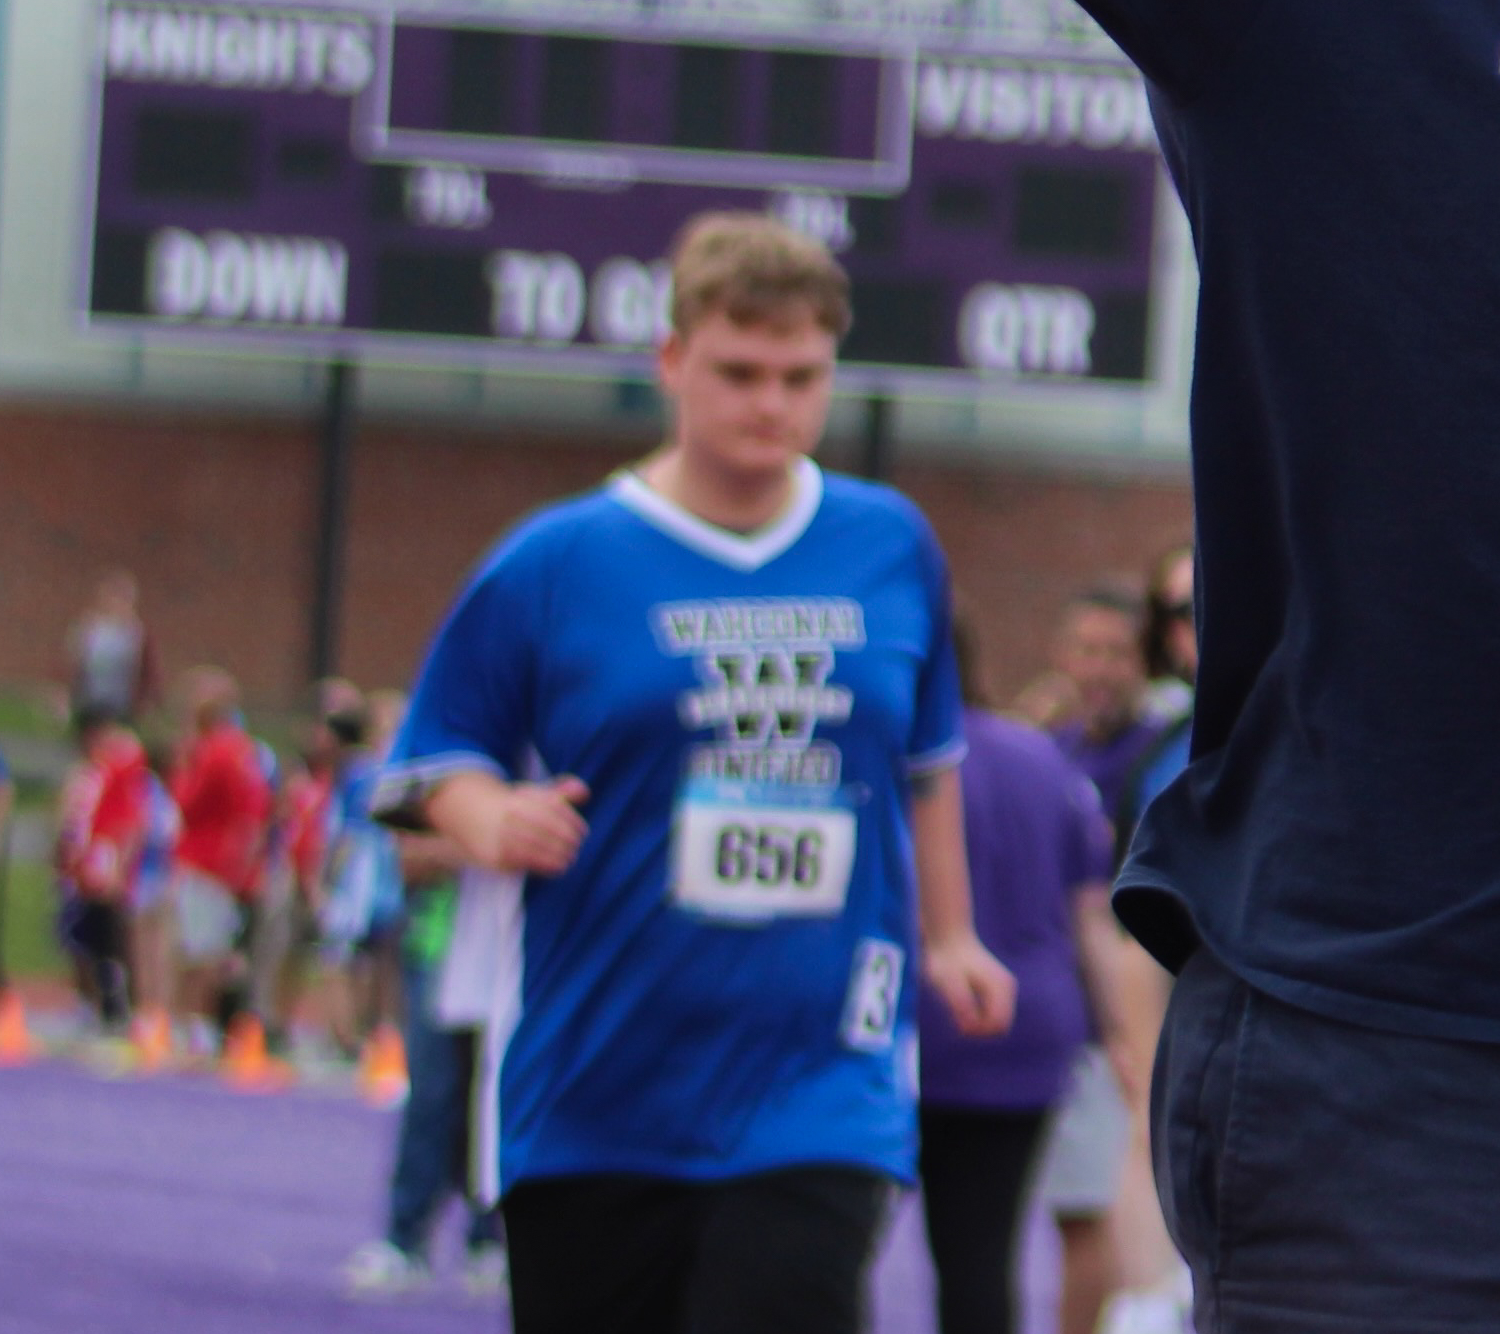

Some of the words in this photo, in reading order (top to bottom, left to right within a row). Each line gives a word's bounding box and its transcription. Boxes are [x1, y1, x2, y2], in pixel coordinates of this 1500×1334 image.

[106, 3, 375, 97] KNIGHTS
[147, 226, 349, 326] DOWN
[486, 250, 585, 341] TO
[958, 283, 1096, 374] QTR
[715, 821, 823, 888] 656
